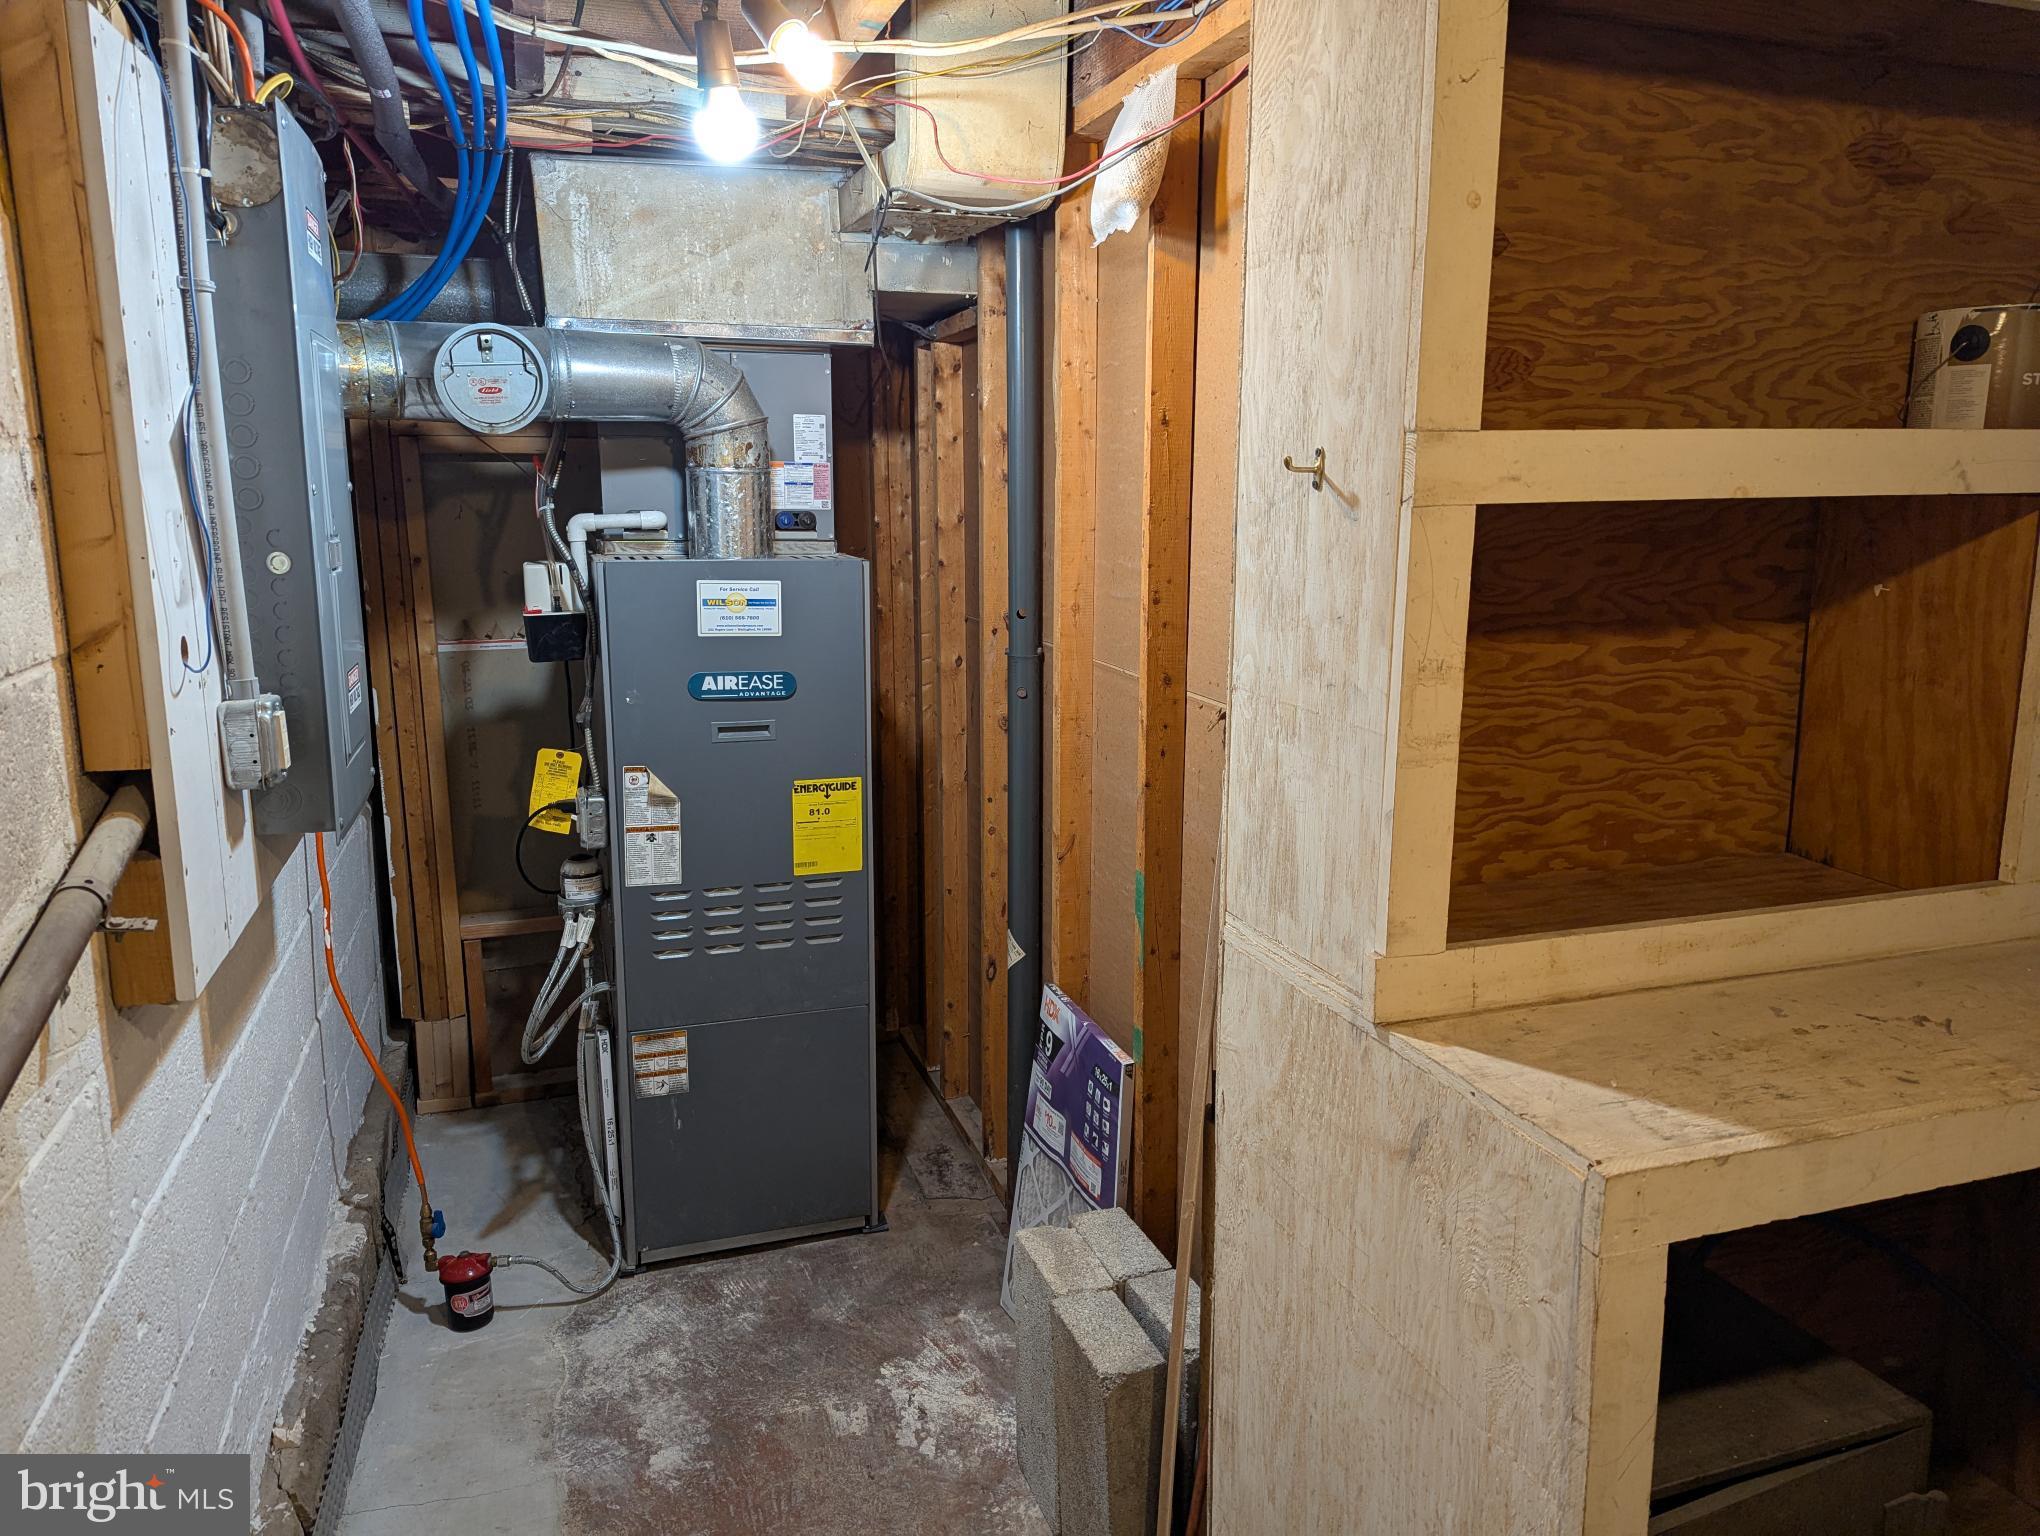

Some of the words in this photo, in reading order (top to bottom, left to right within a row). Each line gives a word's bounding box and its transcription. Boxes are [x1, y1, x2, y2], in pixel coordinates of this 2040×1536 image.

[216, 567, 227, 603] SUNLIGHT
[221, 607, 232, 647] RESISTANT
[701, 674, 784, 690] AIREASE
[739, 690, 786, 698] ADVANTAGE
[794, 781, 857, 796] ENERGYGUIDE
[809, 808, 830, 816] 81.0
[1045, 997, 1061, 1025] HDX
[600, 1038, 609, 1054] HDX
[1045, 1030, 1054, 1057] 9
[1094, 1066, 1113, 1092] 16x25x1
[606, 1117, 615, 1146] 16x25x1
